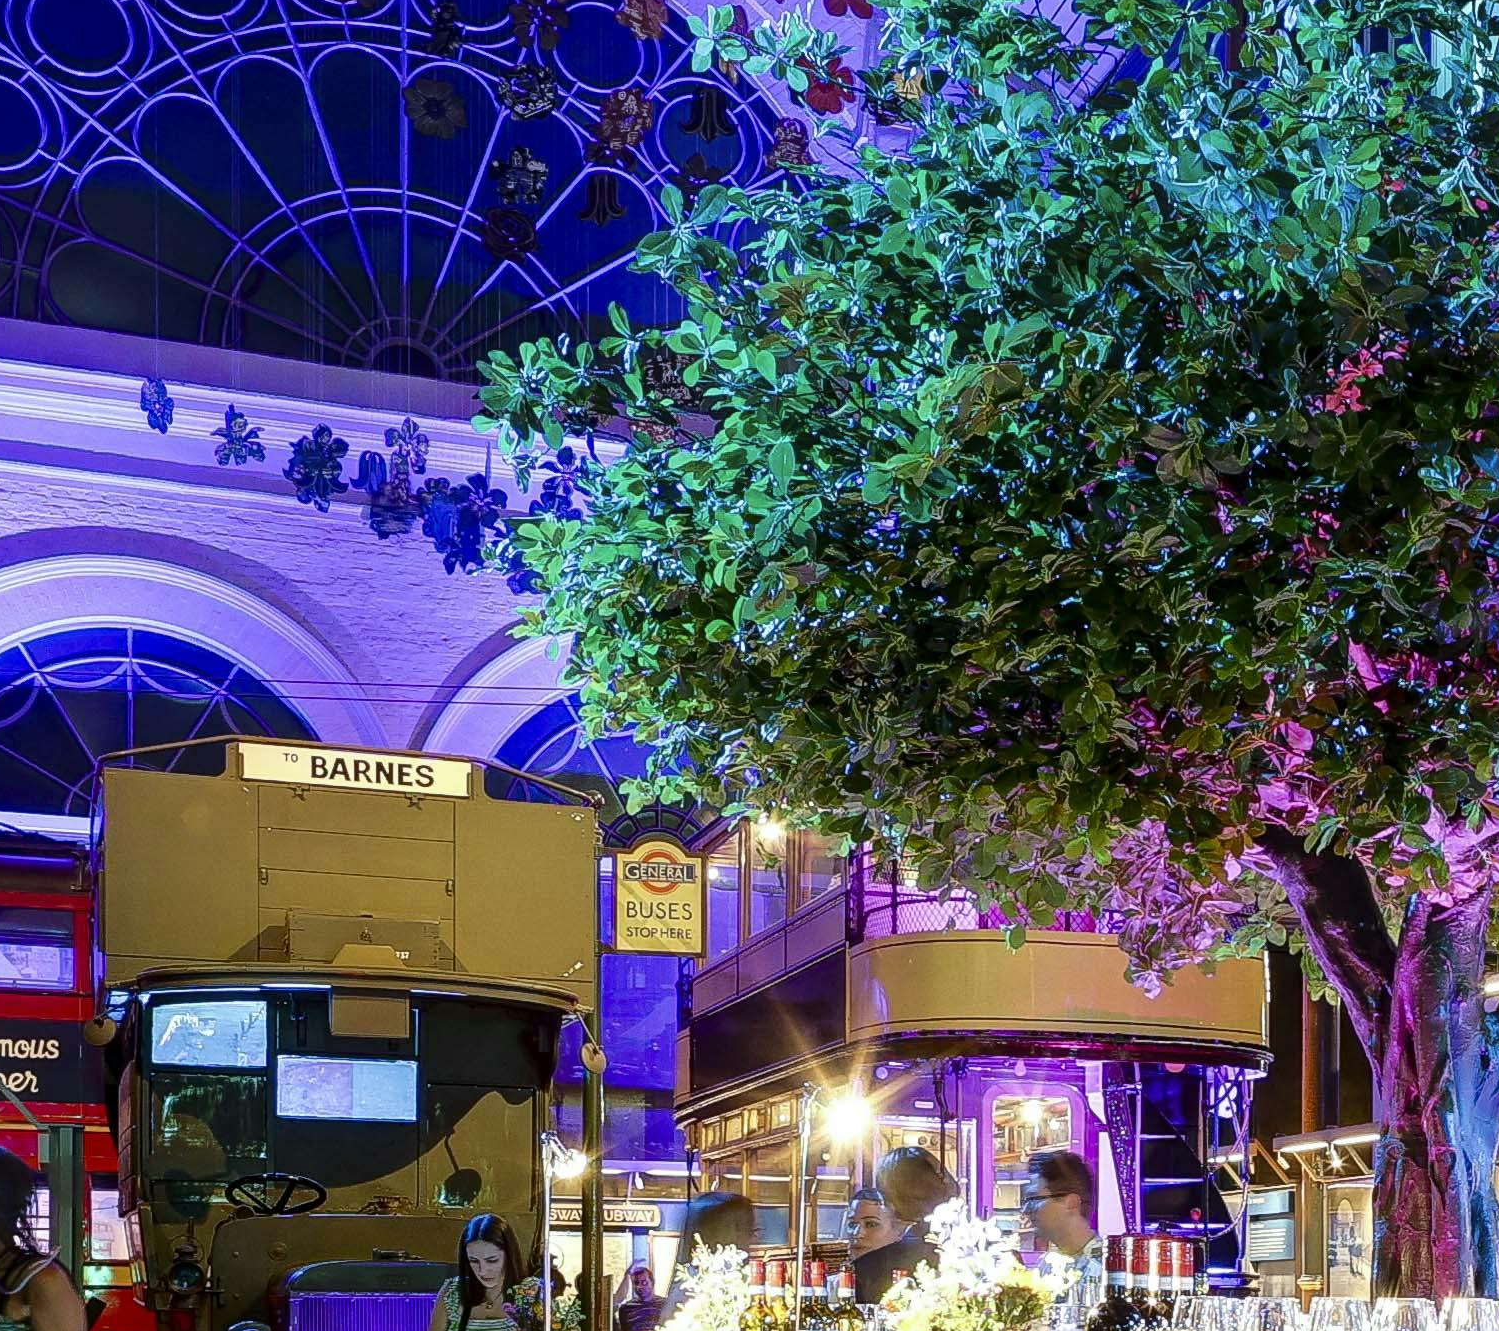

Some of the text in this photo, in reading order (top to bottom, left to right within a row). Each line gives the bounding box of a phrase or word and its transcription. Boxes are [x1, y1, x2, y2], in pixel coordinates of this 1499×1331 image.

[283, 752, 435, 789] TO BARNES
[625, 862, 695, 882] GENERAL
[627, 901, 693, 920] BUSES
[627, 926, 692, 940] STOP HERE
[604, 1210, 653, 1222] UBWAY
